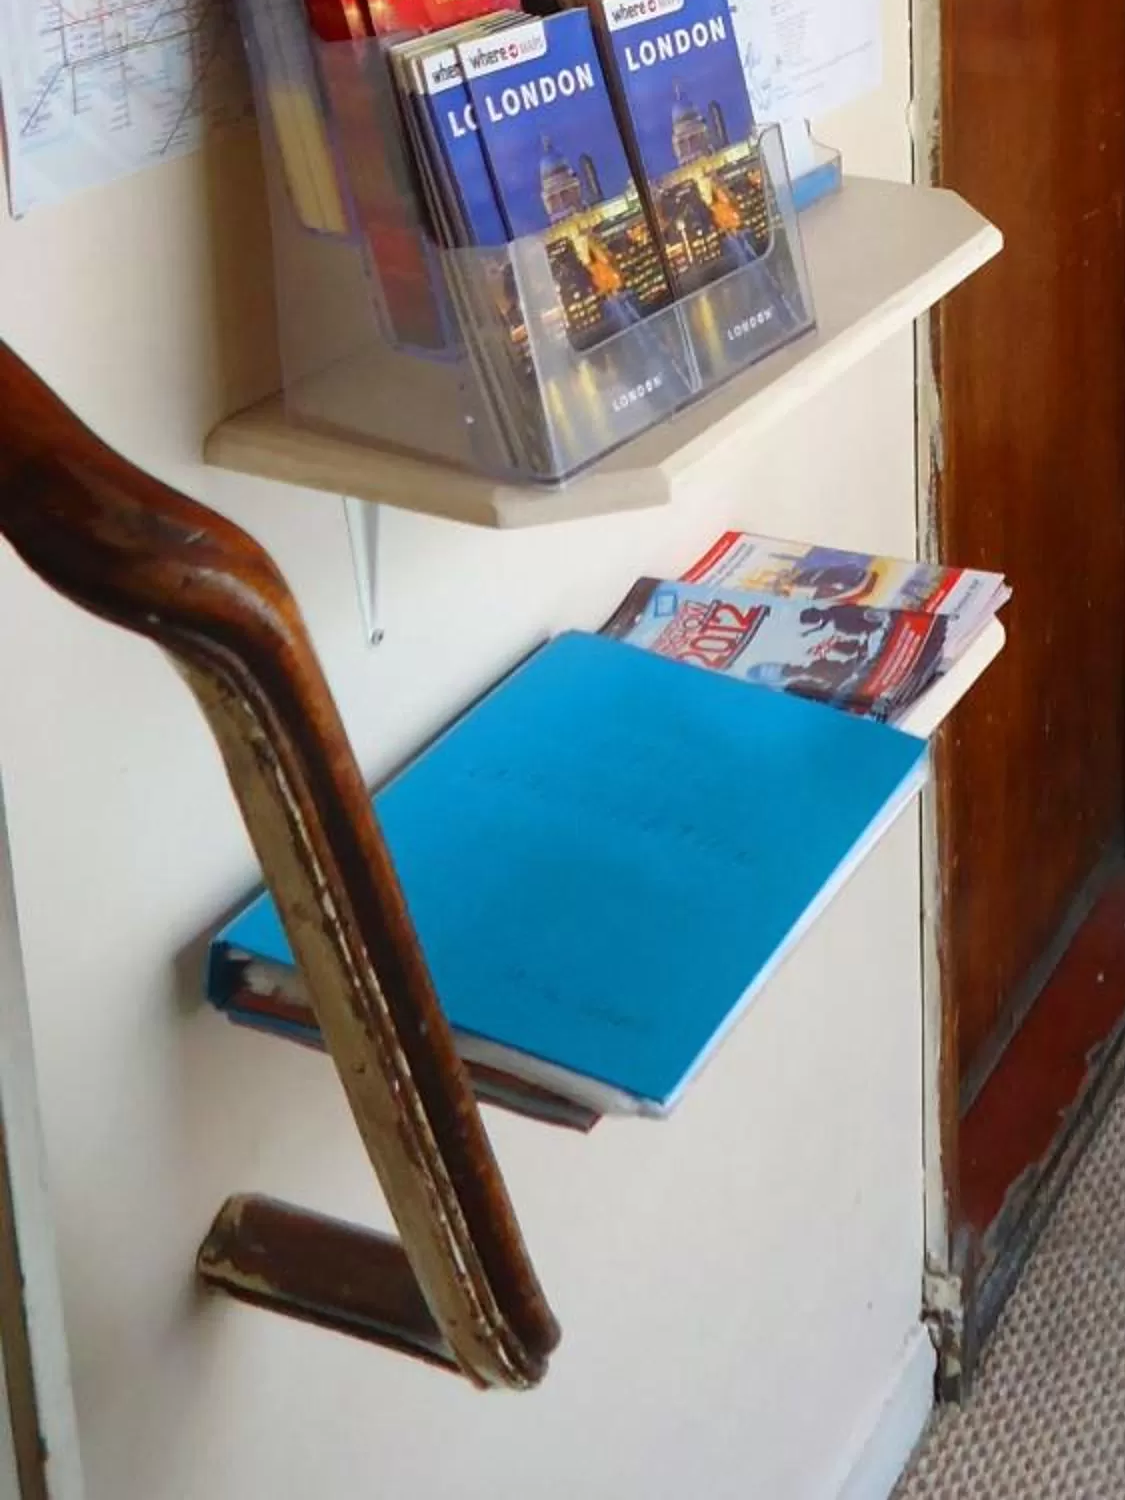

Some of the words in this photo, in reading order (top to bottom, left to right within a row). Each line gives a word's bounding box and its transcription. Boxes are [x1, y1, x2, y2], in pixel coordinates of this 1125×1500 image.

[611, 0, 647, 22] where
[469, 44, 509, 70] where
[625, 16, 728, 72] LONDON
[485, 63, 596, 123] LONDON
[727, 306, 776, 342] LONDON
